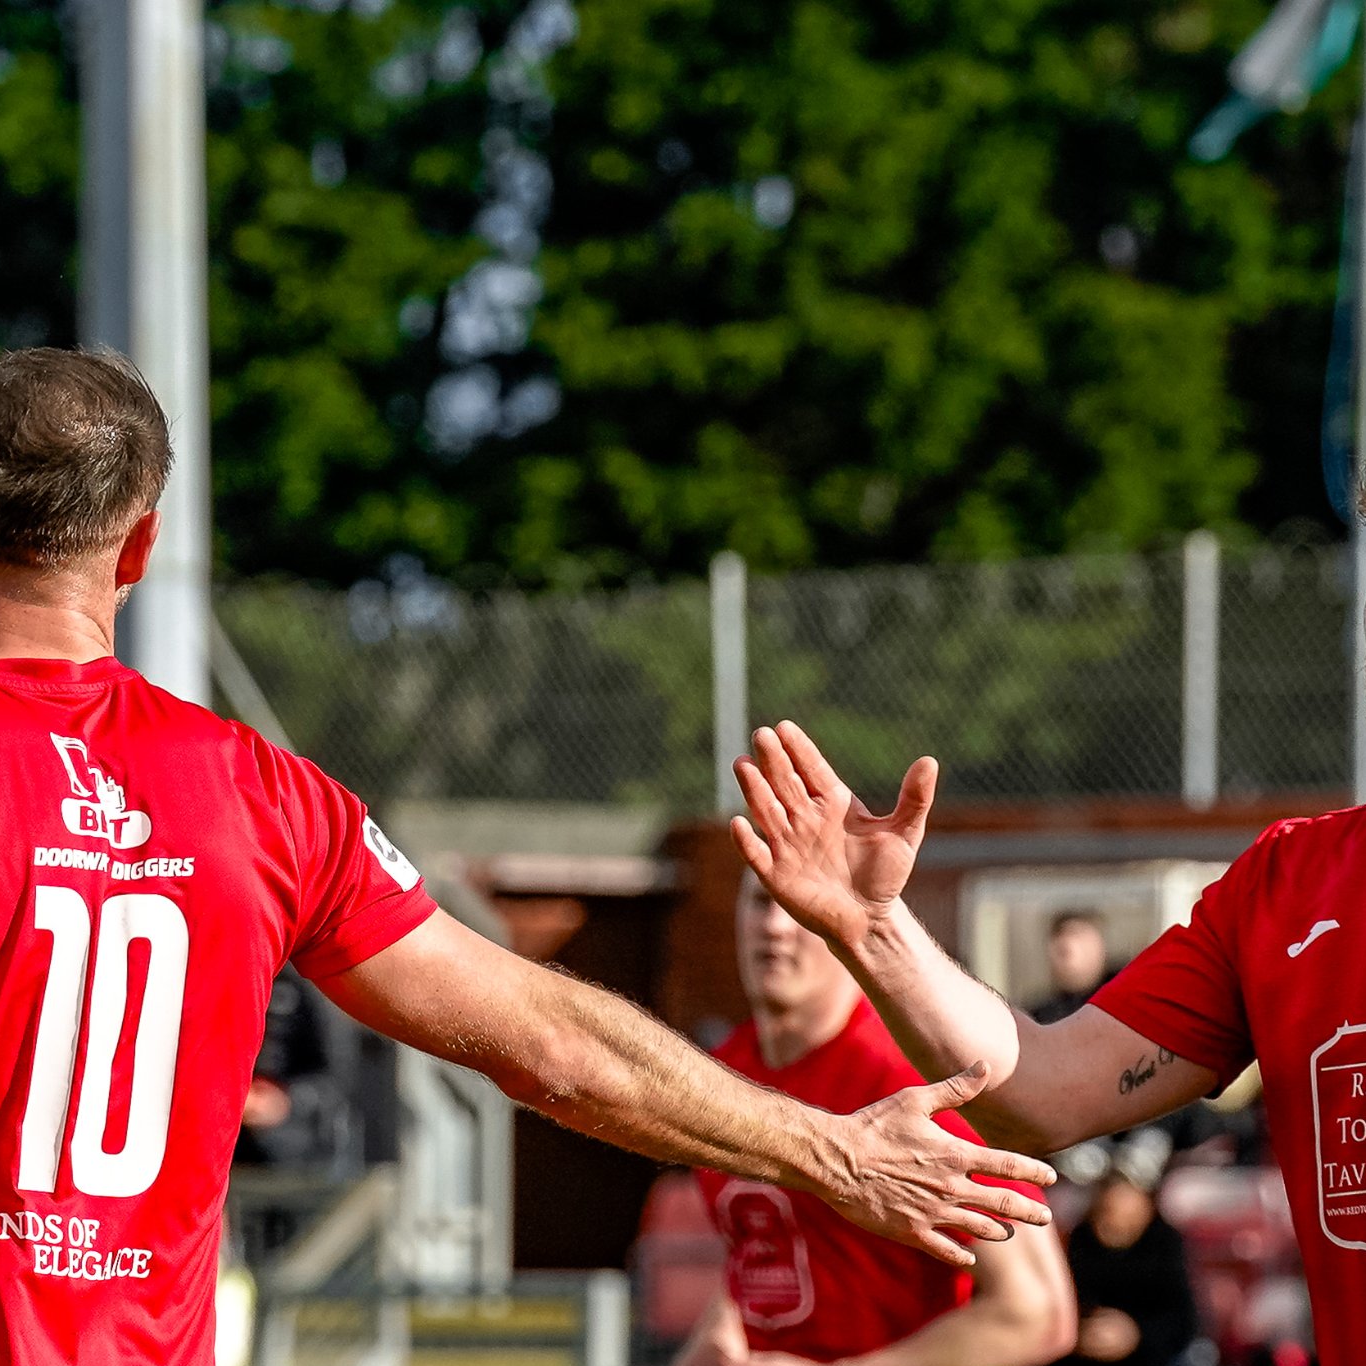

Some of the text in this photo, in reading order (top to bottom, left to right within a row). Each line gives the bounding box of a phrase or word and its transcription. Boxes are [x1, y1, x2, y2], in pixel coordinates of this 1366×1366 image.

[33, 847, 195, 880] DOORWA DIGGERS
[17, 884, 190, 1198] 10
[67, 1216, 100, 1248] OF
[33, 1243, 153, 1281] ELEGACE
